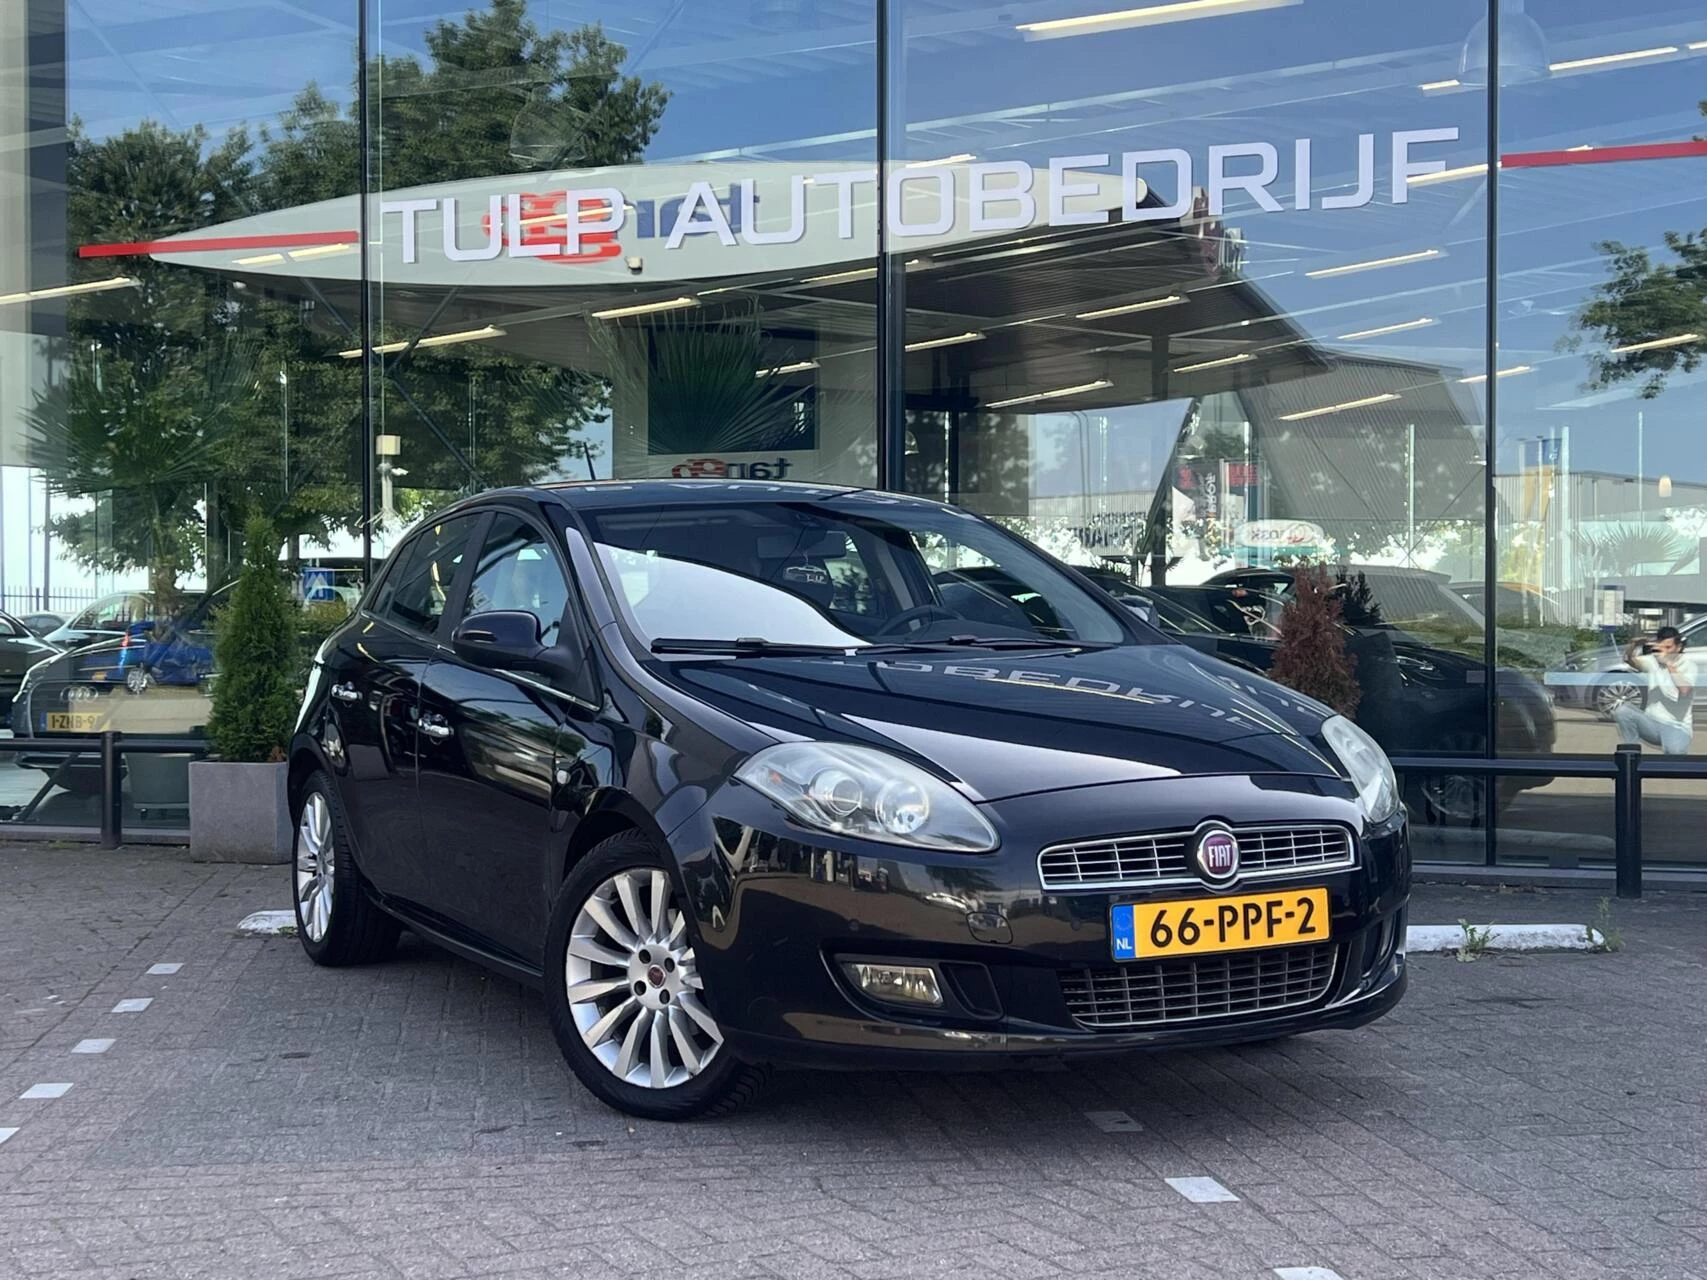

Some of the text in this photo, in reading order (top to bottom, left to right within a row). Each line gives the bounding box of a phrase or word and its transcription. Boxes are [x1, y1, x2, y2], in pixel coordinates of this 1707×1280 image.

[381, 127, 1460, 264] TULP AUTOBEDRIJF
[1208, 844, 1231, 867] FIAT
[1116, 897, 1316, 950] NL 66-PPF-2
